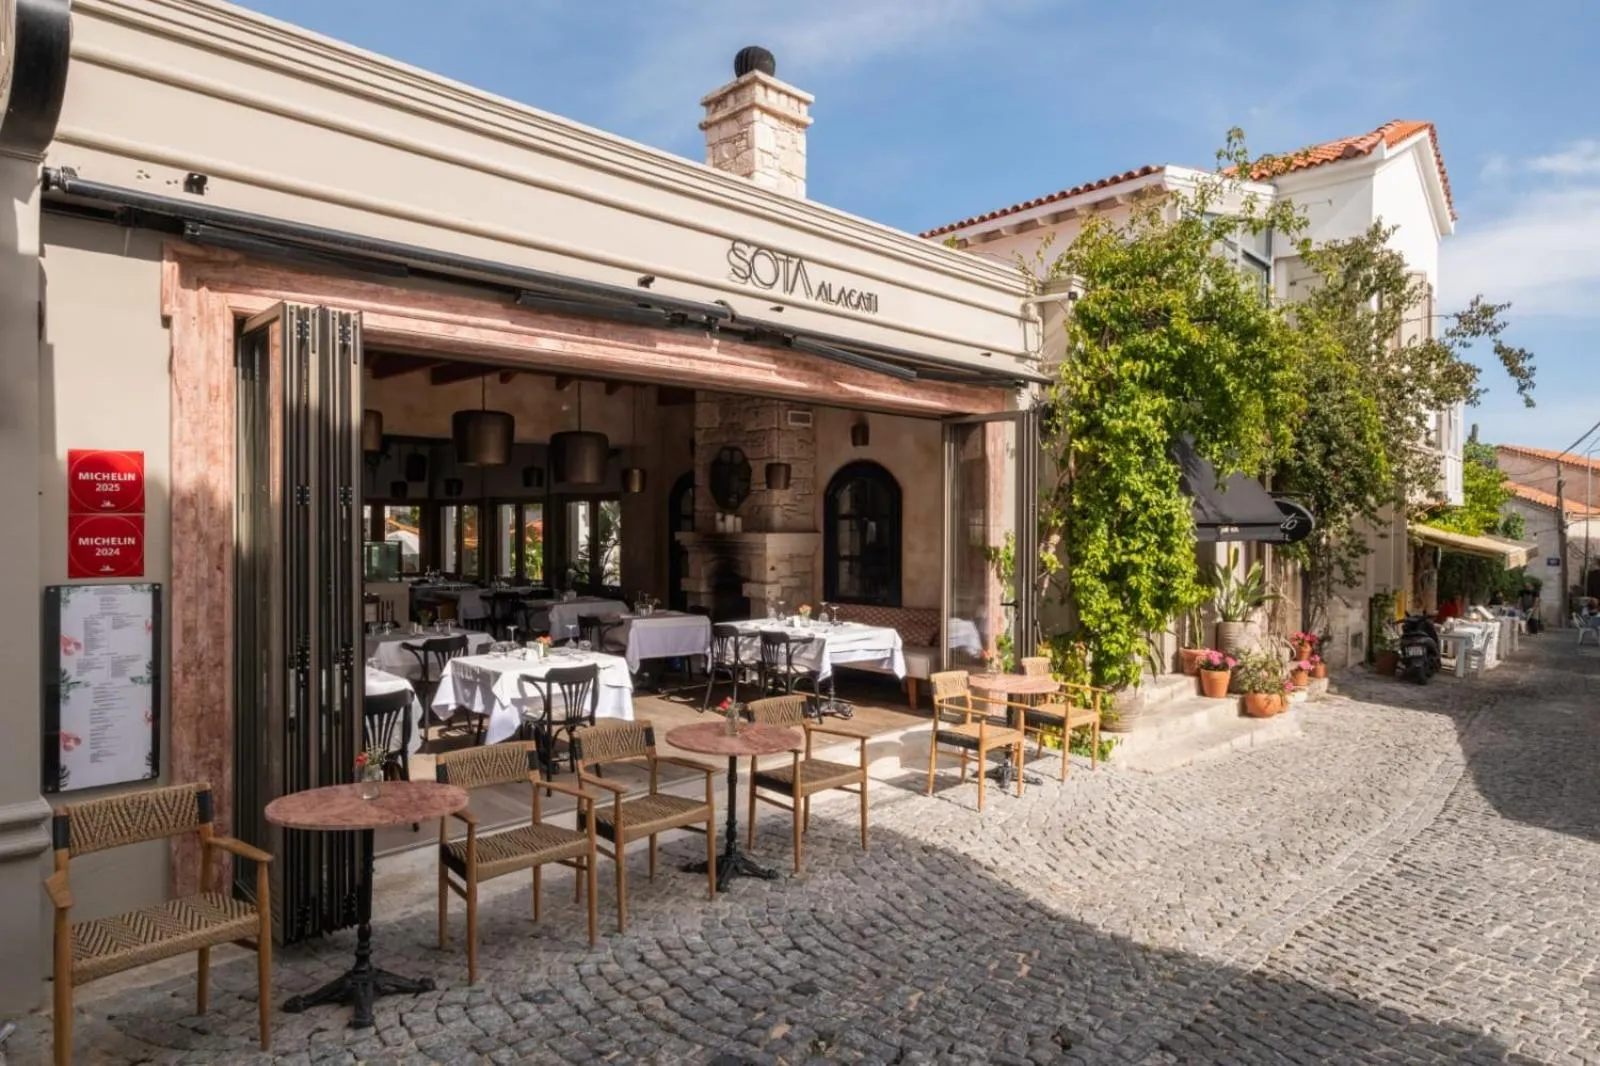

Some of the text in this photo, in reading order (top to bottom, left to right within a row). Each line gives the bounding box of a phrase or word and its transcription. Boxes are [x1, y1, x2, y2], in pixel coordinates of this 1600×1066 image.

[727, 239, 814, 298] SOTA
[78, 472, 136, 481] MICHELIN
[95, 483, 120, 492] 2025
[78, 537, 136, 546] MICHELIN
[95, 547, 120, 556] 2024
